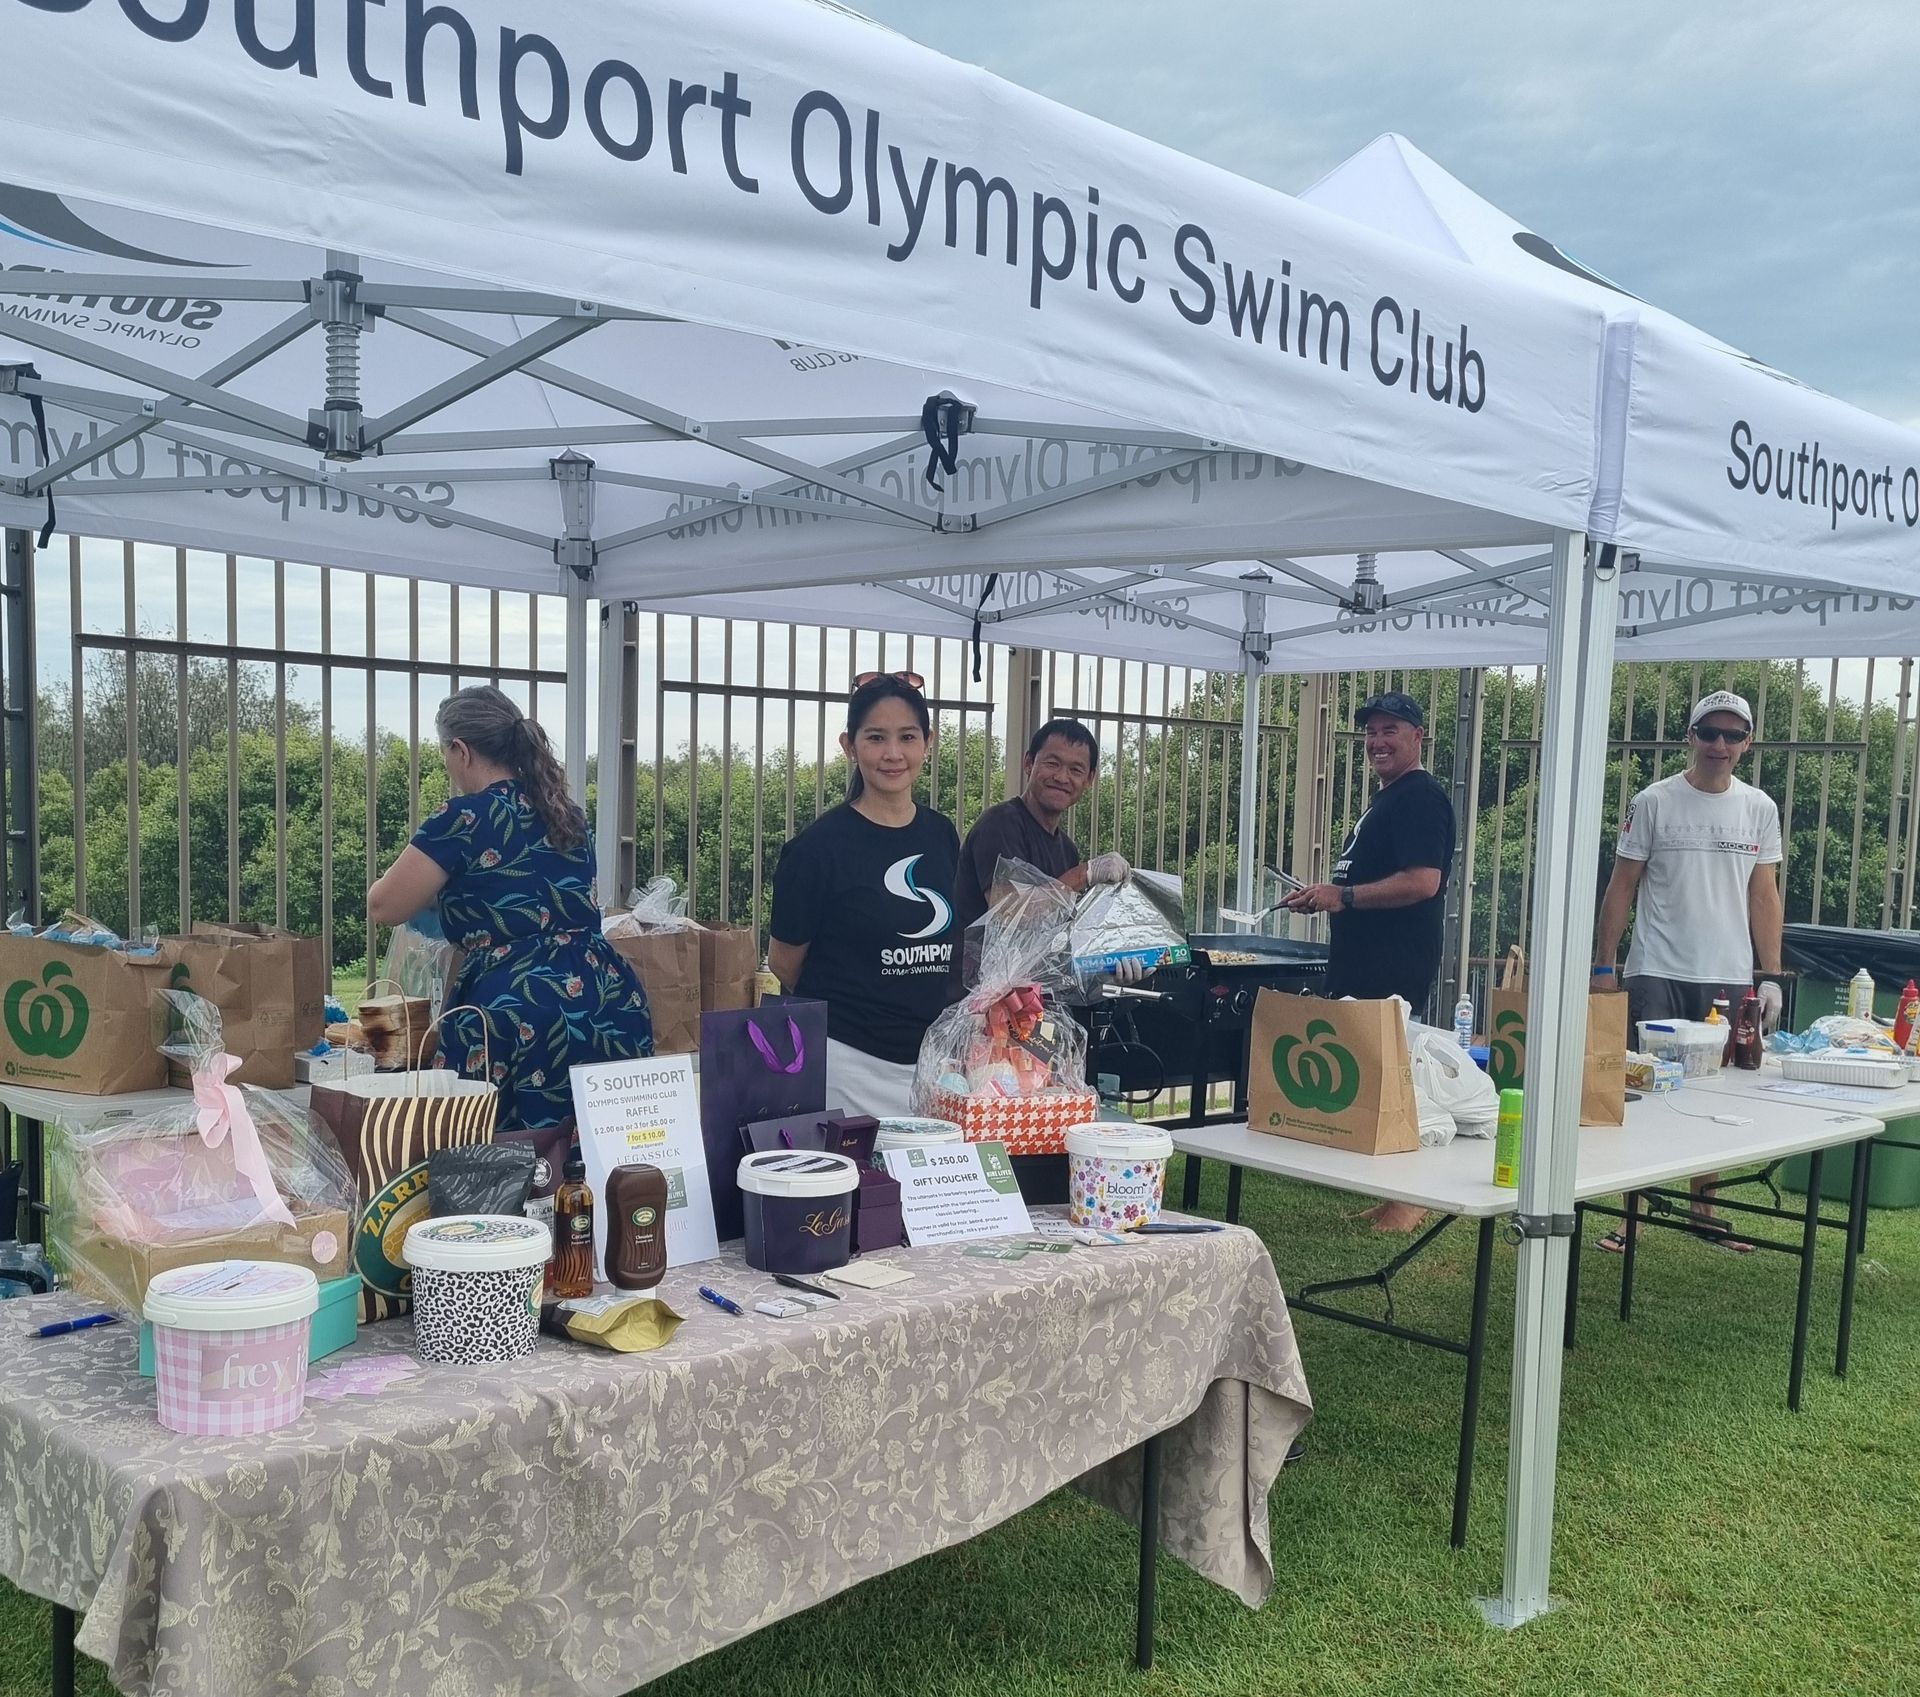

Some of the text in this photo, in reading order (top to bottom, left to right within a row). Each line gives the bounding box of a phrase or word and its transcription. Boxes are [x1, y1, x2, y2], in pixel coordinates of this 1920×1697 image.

[16, 0, 1485, 414] uthport Olympic Swim Club
[1727, 420, 1894, 531] Southport
[1174, 948, 1187, 957] 20
[604, 1069, 686, 1091] SOUTHPORT
[587, 1090, 677, 1108] OLYMPIC SWIMMING CLUB
[626, 1105, 659, 1117] RAFFLE
[600, 1125, 615, 1134] 2.00
[626, 1123, 633, 1131] or
[634, 1121, 638, 1129] 3
[639, 1120, 649, 1129] for
[649, 1118, 668, 1128] $5.00
[632, 1133, 642, 1142] for
[642, 1132, 647, 1140] $
[648, 1130, 666, 1140] 10.00
[616, 1148, 681, 1165] LEGASSICK
[929, 1158, 937, 1167] $
[938, 1155, 970, 1166] 250.00
[912, 1177, 934, 1187] GIFT
[935, 1172, 979, 1184] VOUCHER
[1107, 1182, 1144, 1195] bloom
[222, 1352, 290, 1393] hey
